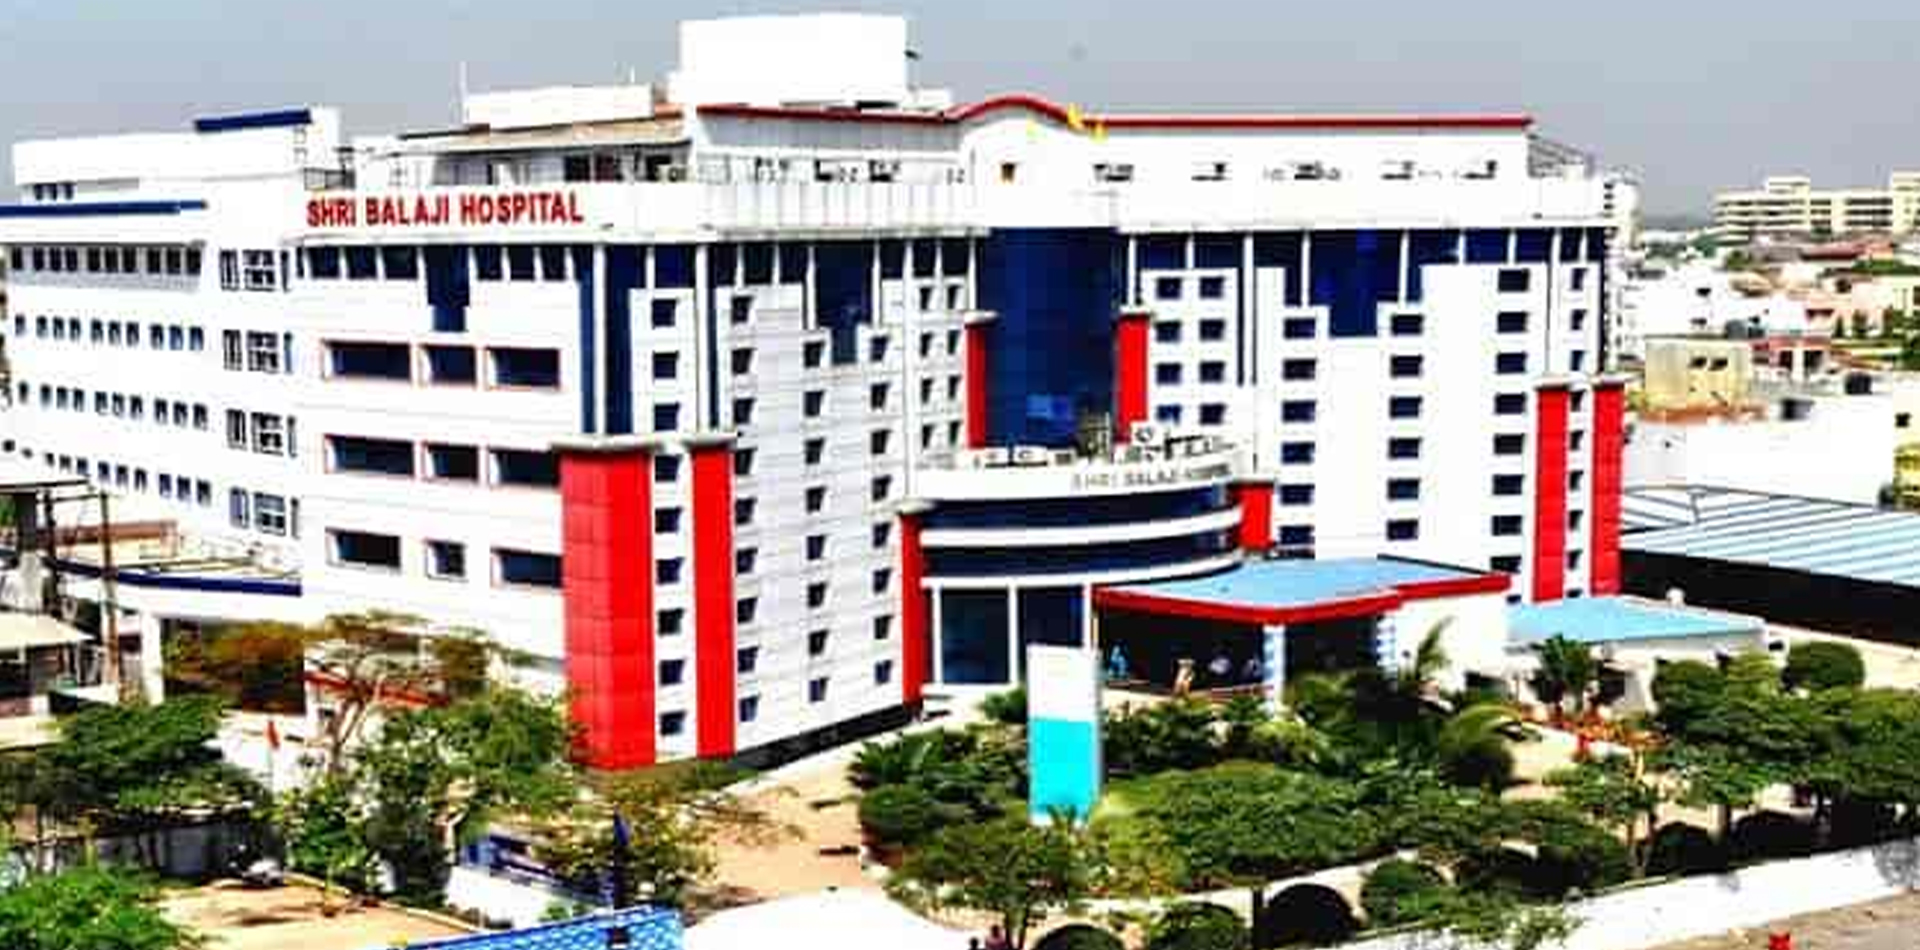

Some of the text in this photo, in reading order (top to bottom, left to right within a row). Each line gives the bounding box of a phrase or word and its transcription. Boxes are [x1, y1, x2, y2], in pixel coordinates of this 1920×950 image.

[306, 191, 584, 227] SHRI BALAJI HOSPITAL
